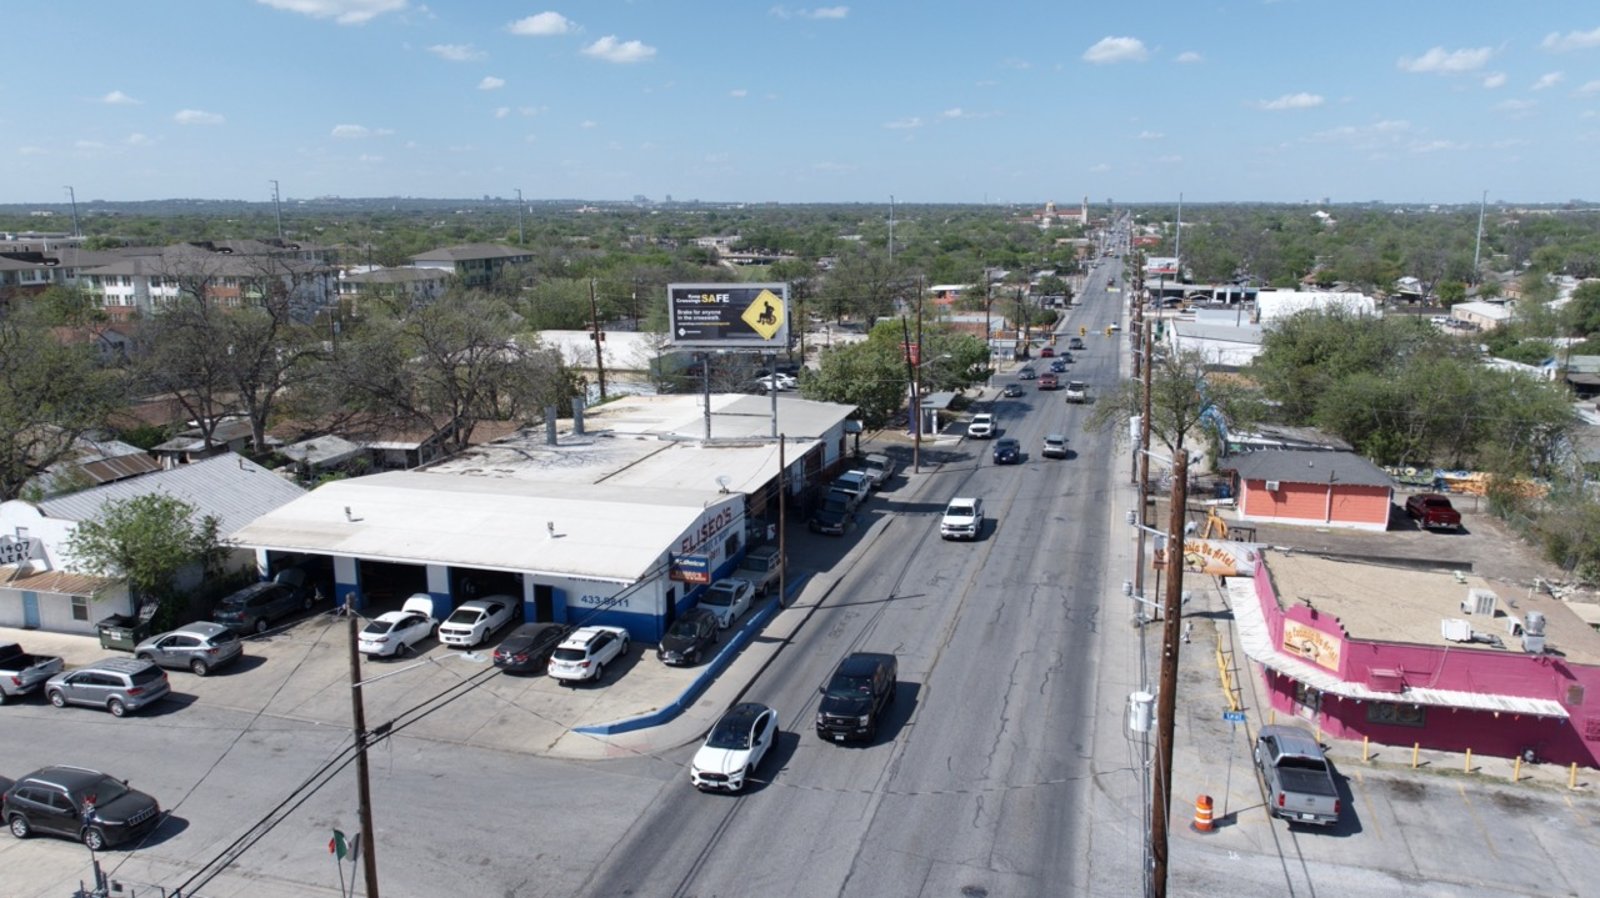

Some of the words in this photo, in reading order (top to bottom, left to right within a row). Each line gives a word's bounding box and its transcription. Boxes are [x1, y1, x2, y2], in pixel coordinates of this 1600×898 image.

[701, 294, 730, 303] SAFE
[682, 507, 732, 553] ELISEO'S
[1, 541, 30, 554] 1407
